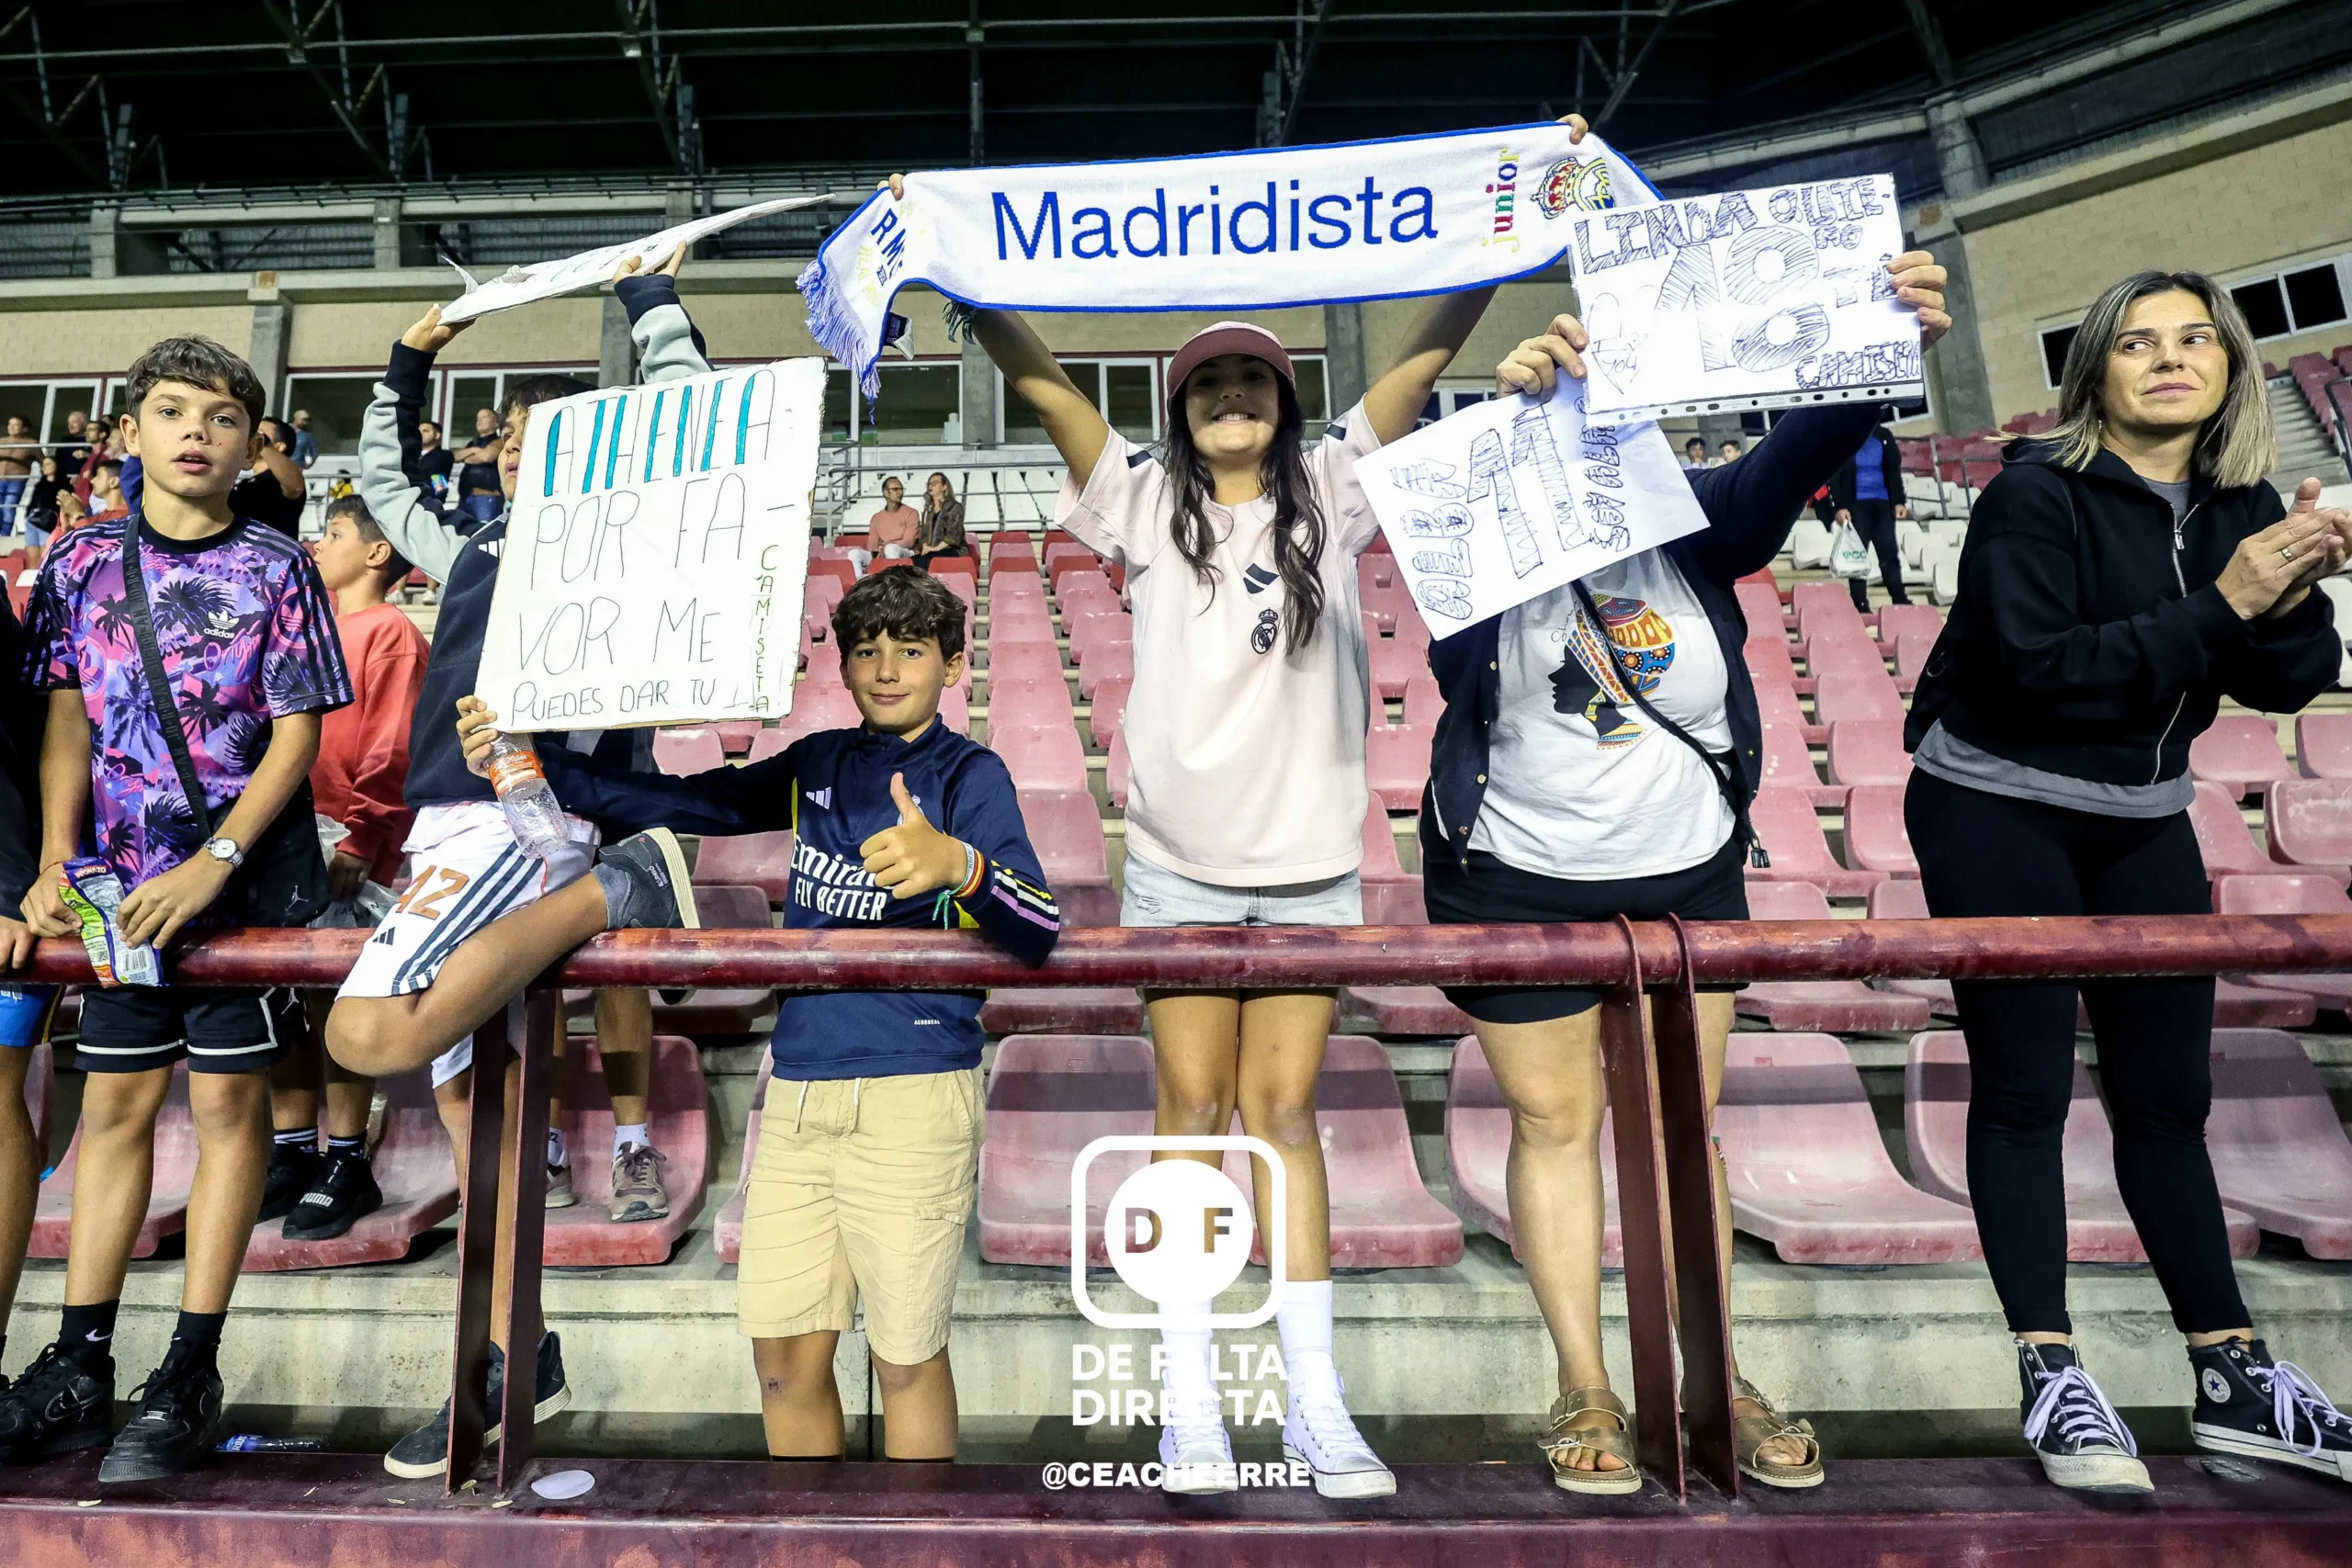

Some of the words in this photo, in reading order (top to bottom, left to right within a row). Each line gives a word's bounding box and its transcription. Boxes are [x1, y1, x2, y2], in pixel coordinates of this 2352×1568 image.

[991, 175, 1439, 261] Madridista
[1481, 147, 1521, 254] junior
[1574, 191, 1758, 275] LINDA
[544, 369, 775, 497] ATHENEA
[530, 490, 640, 591] POR
[203, 627, 235, 639] adidas
[519, 596, 621, 675] VOR
[652, 597, 722, 663] ME
[754, 545, 779, 713] CAMISETA
[511, 681, 603, 727] PUEDES
[619, 679, 670, 713] DAR
[690, 678, 717, 705] TU
[791, 834, 895, 890] Emira
[795, 876, 815, 908] FLY
[816, 886, 888, 921] BETTER
[299, 1192, 334, 1208] PUMA
